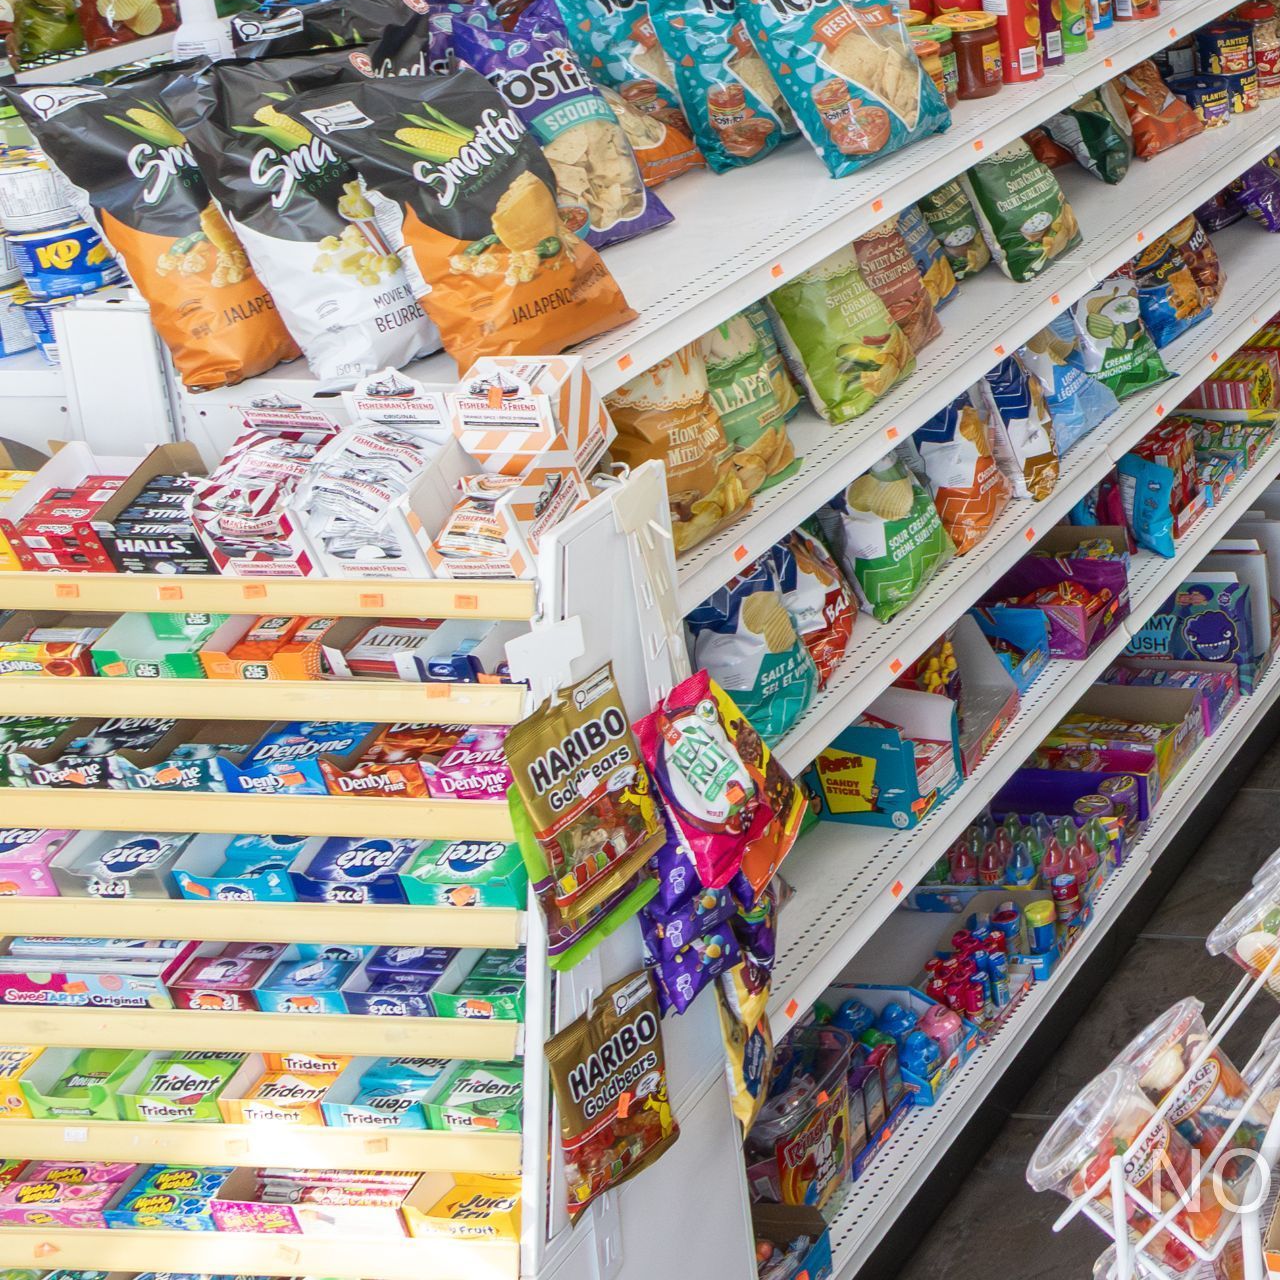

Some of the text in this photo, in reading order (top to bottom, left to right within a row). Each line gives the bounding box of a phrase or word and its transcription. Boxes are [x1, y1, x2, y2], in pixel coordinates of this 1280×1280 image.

[1217, 36, 1249, 48] PLANTERS
[37, 239, 83, 272] KD
[373, 287, 401, 308] MOVIE
[511, 284, 573, 327] JALAPEÑO
[375, 304, 425, 334] BEURRE
[357, 400, 435, 412] FISHERMAN'S FRIEND
[507, 402, 537, 413] FRIEND
[383, 412, 418, 421] ORIGINAL
[116, 538, 188, 554] HALLS
[889, 530, 910, 551] SOUR
[760, 665, 786, 687] SALT
[253, 737, 353, 762] Dentyne
[529, 708, 626, 794] HARIBO
[818, 753, 864, 776] POPEYE
[384, 782, 406, 793] FIRE
[440, 771, 507, 793] Dentyne
[487, 785, 505, 793] ICE
[825, 776, 860, 787] CANDY
[826, 784, 862, 797] STICKS
[102, 843, 169, 865] excel
[336, 845, 405, 868] excel
[436, 842, 506, 866] excel
[89, 880, 130, 897] excel
[216, 888, 255, 902] excel
[327, 886, 369, 903] excel
[93, 995, 146, 1007] Original
[370, 998, 407, 1016] excel
[284, 1057, 339, 1071] Trident
[568, 1010, 658, 1103] HARIBO
[150, 1073, 221, 1093] Trident
[257, 1083, 328, 1100] Trident
[453, 1076, 522, 1097] Trident
[584, 1050, 657, 1120] Goldbears
[138, 1104, 195, 1117] Trident
[244, 1108, 300, 1121] Trident
[343, 1113, 400, 1125] Trident
